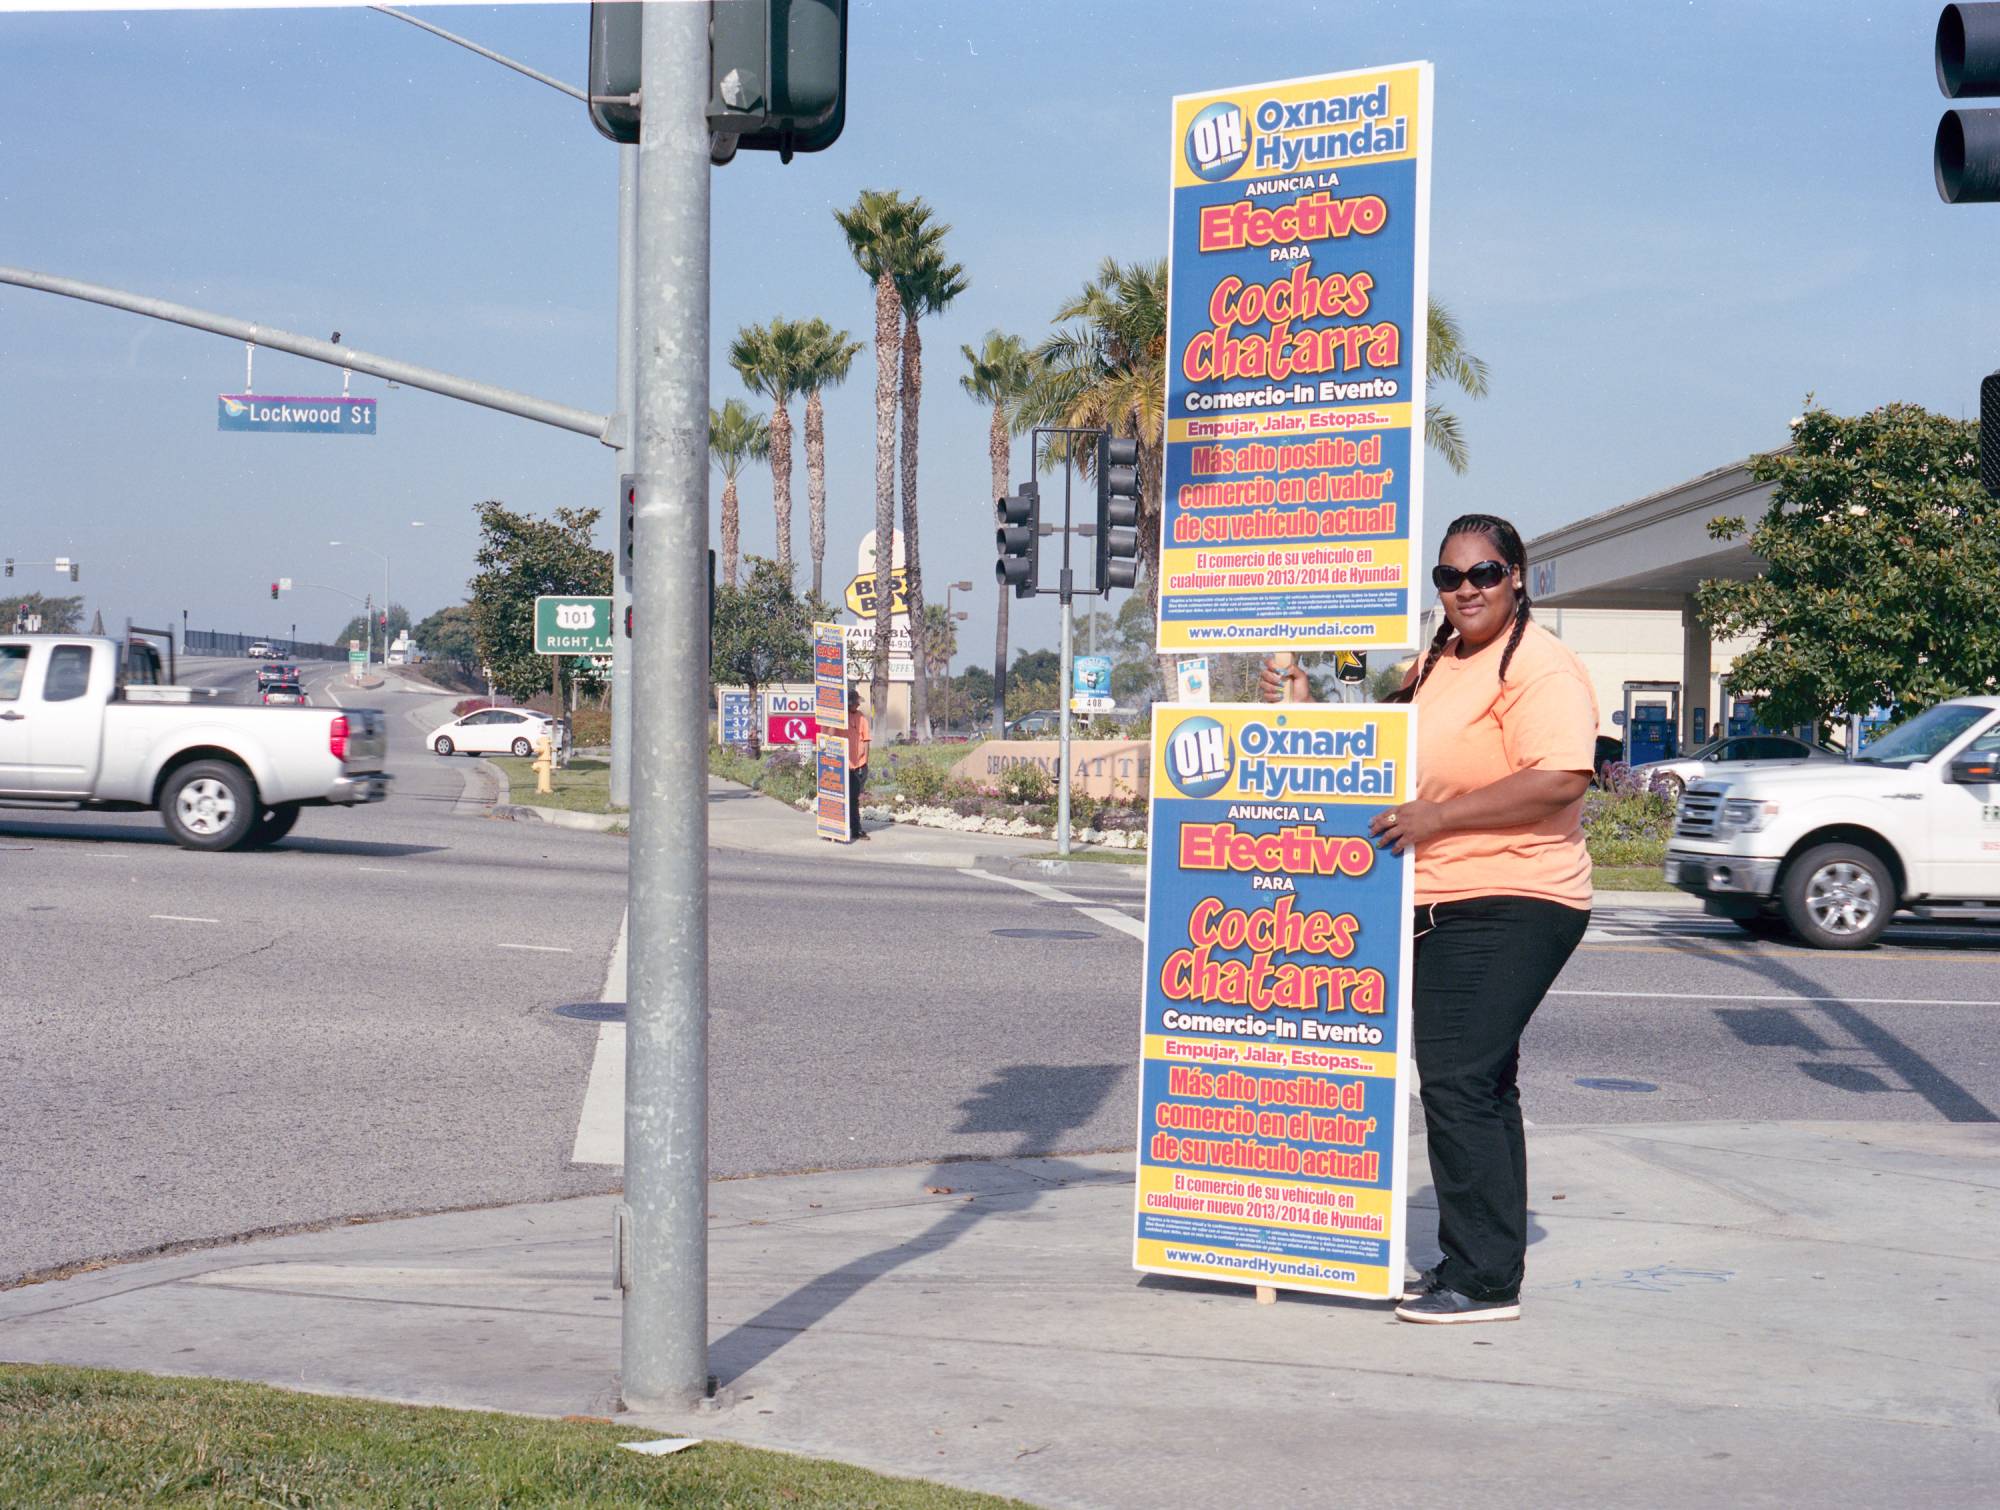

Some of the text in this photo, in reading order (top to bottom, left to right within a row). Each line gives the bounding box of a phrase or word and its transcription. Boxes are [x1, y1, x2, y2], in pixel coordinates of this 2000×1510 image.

[1256, 83, 1388, 132] Oxnard
[1255, 117, 1407, 171] Hyundai
[1245, 172, 1339, 197] ANUNCIA LA
[1200, 192, 1387, 252] Efectivo
[1270, 246, 1311, 262] PARA
[1210, 261, 1374, 326] Coches
[1183, 321, 1400, 381] Chatarra
[1185, 379, 1397, 410] Comercio-In Evento
[250, 403, 371, 424] Lockwood St
[1188, 411, 1389, 437] Empujar, Jalar, Estopas...
[1193, 435, 1380, 475] Más alto posible el
[1179, 477, 1274, 509] comercio
[1278, 479, 1304, 502] en
[1307, 473, 1327, 501] el
[1175, 502, 1396, 543] de su vehículo actual!
[1197, 553, 1207, 569] El
[1209, 551, 1264, 568] comercio
[1267, 551, 1282, 566] de
[1285, 551, 1299, 566] su
[1356, 549, 1372, 563] en
[855, 576, 911, 596] BS
[1170, 566, 1400, 589] cualquier nuevo 2013/2014 de Hyundai
[861, 592, 912, 612] BY
[564, 612, 587, 624] 101
[1189, 623, 1374, 640] www.OxnardHyundai.com
[547, 637, 613, 647] RIGHT LA
[817, 645, 841, 660] CASH
[733, 705, 748, 715] 3.6
[773, 697, 814, 711] Mobi
[733, 717, 748, 727] 3.7
[733, 730, 748, 740] 3.8
[788, 720, 806, 738] K
[1239, 721, 1375, 758] Oxnard
[1075, 757, 1105, 776] AT
[1238, 758, 1394, 799] Hyundai
[1228, 805, 1325, 822] ANUNCIA LA
[1180, 822, 1374, 876] Efectivo
[1253, 876, 1295, 891] PARA
[1189, 894, 1359, 958] Coches
[1161, 945, 1385, 1014] Chatarra
[1162, 1009, 1383, 1044] Comercio-In Evento
[1166, 1040, 1373, 1070] Empujar, Jalar, Estopas...
[1169, 1067, 1364, 1111] Más alto posible el
[1156, 1102, 1254, 1135] comercio
[1258, 1116, 1286, 1138] en
[1288, 1111, 1309, 1141] el
[1151, 1132, 1379, 1182] de su vehículo actual!
[1175, 1175, 1185, 1190] El
[1187, 1177, 1245, 1197] comercio
[1247, 1182, 1262, 1199] de
[1265, 1186, 1280, 1201] su
[1338, 1193, 1354, 1208] en
[1147, 1192, 1383, 1232] cualquier nuevo 2013/2014 de Hyundai
[1166, 1249, 1356, 1282] www.OxnardHyundai.com
